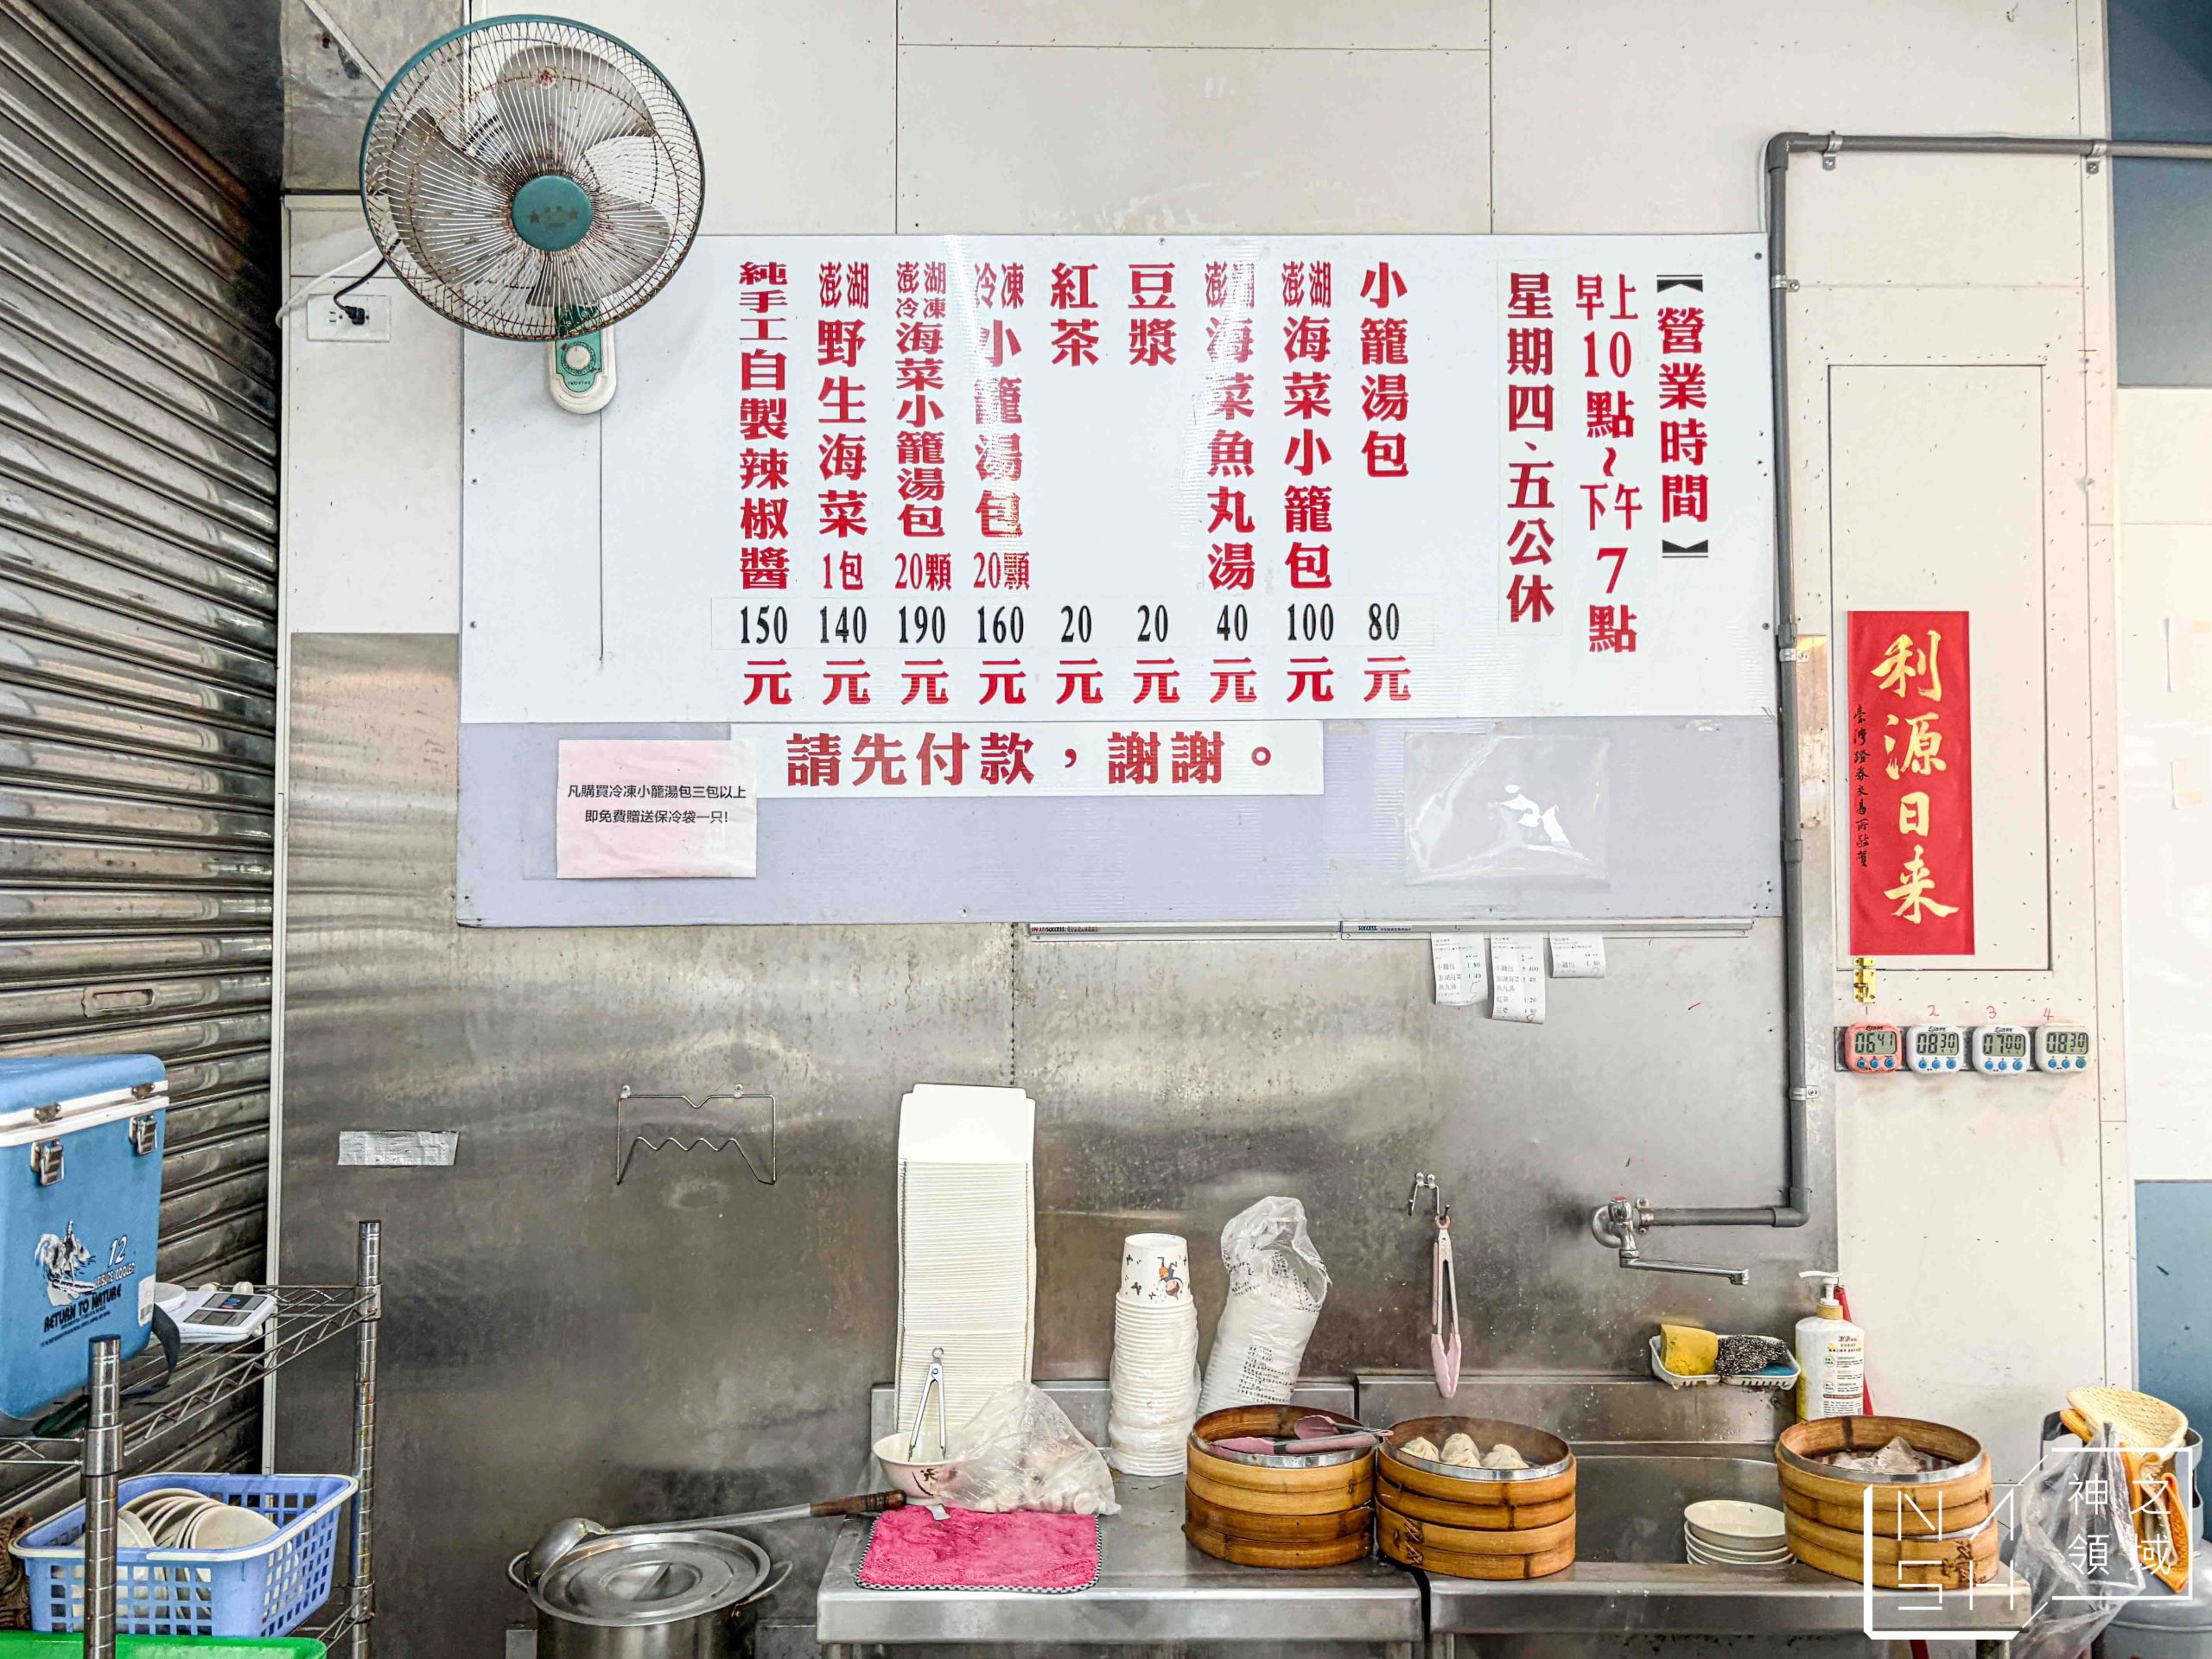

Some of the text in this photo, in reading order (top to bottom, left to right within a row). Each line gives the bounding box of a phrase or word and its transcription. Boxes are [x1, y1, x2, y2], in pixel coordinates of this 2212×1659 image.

[1507, 272, 1554, 623] 星期四、五公休
[741, 262, 792, 706] 純手工自製辣椒醬 150 元
[1051, 262, 1103, 705] 紅茶 20 元
[1128, 263, 1180, 704] 豆漿 20 元
[1282, 261, 1335, 703] 澎湖海菜小籠包 100 元
[1360, 262, 1411, 702] 小籠湯包 80 元
[820, 606, 867, 644] 140
[899, 606, 945, 644] 190
[977, 606, 1024, 644] 160
[1217, 604, 1248, 641] 40
[823, 659, 871, 706] 元
[902, 659, 950, 705] 元
[980, 658, 1027, 705] 元
[1210, 658, 1257, 704] 元
[568, 784, 747, 799] 凡購買冷凍小籠湯包三包以上
[1927, 1004, 1940, 1017] 2
[1986, 1005, 1998, 1019] 3
[2042, 1007, 2054, 1020] 4
[108, 1234, 129, 1268] 12
[44, 1304, 76, 1333] RETURN
[79, 1298, 91, 1314] TO
[92, 1283, 123, 1309] NATURE
